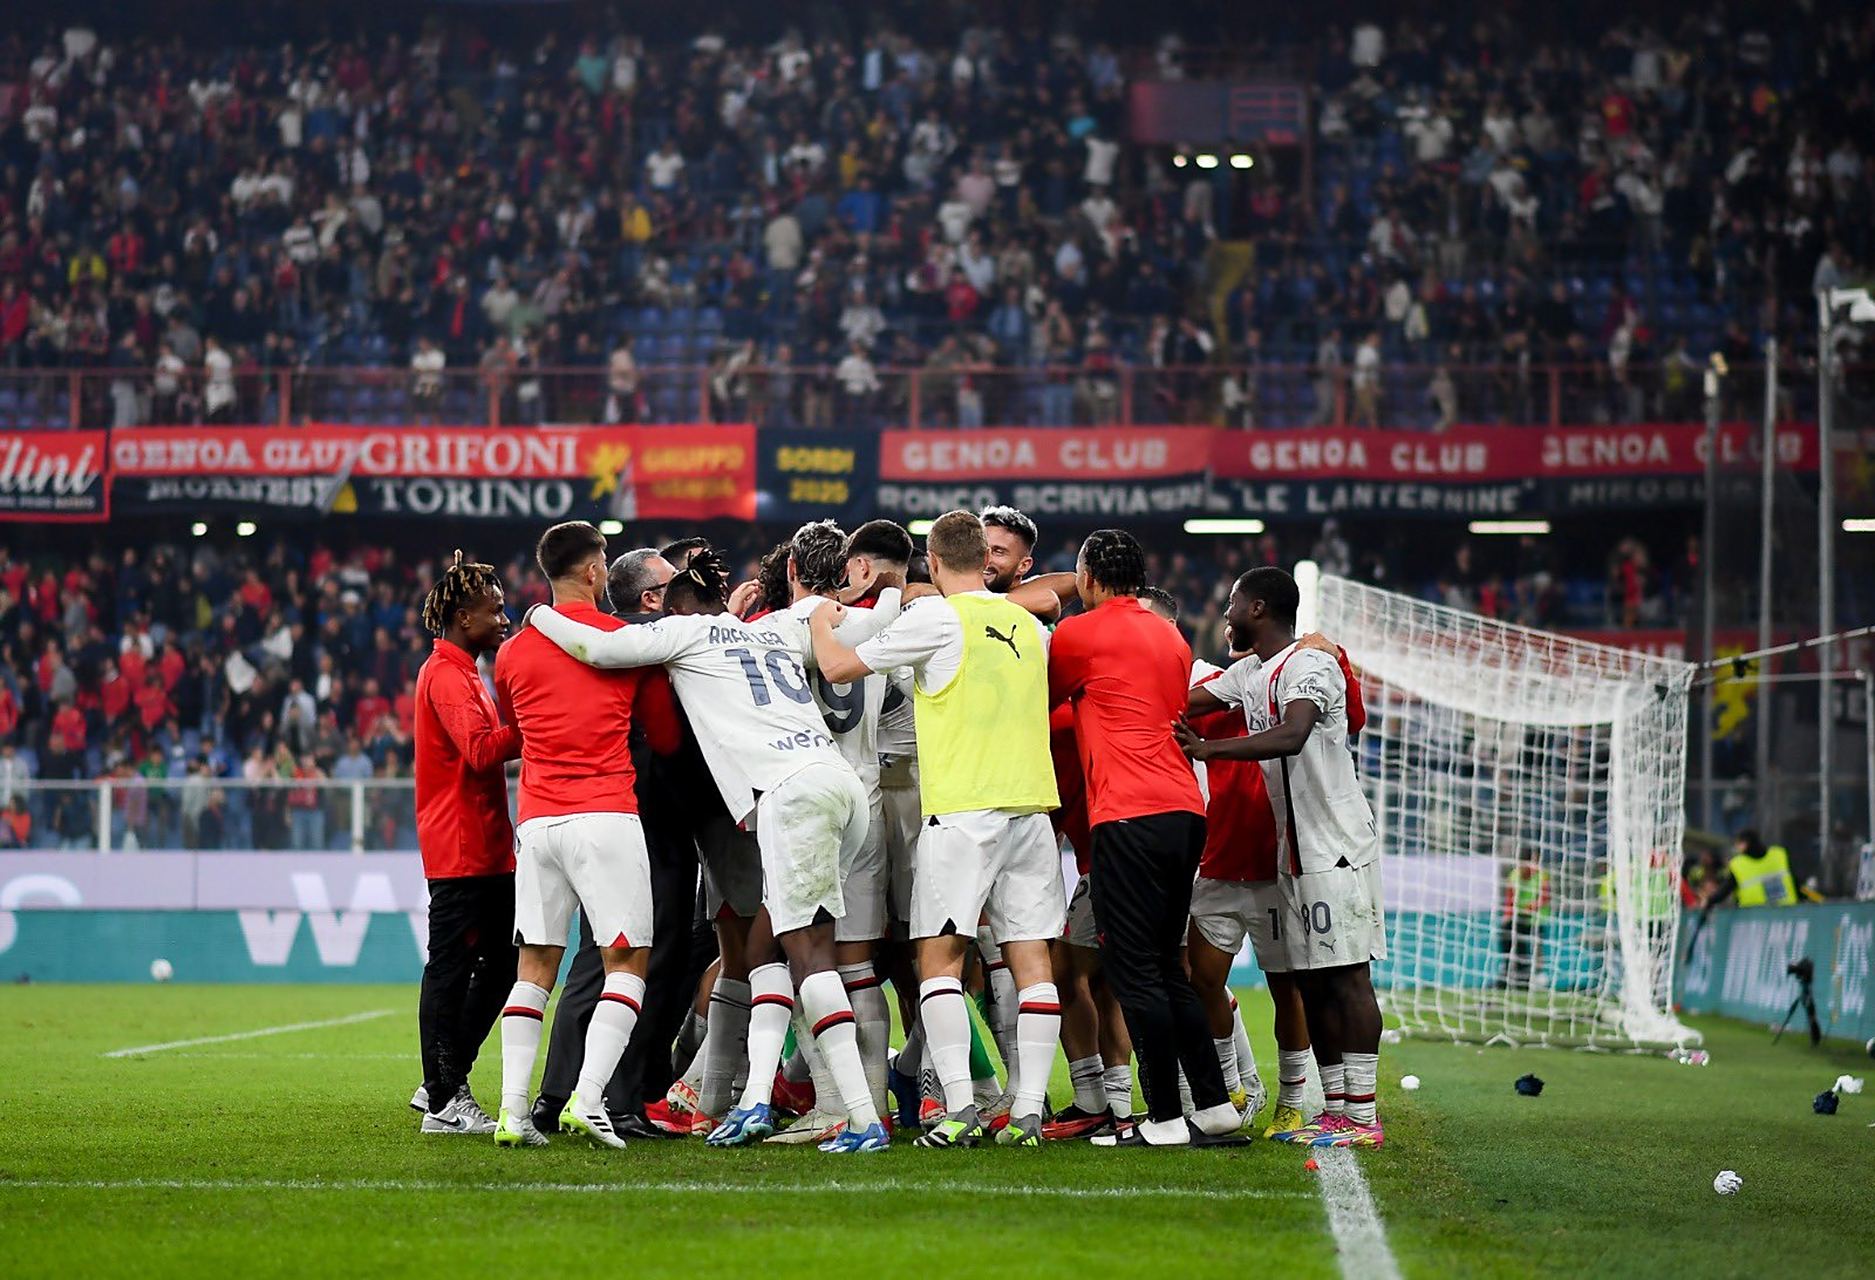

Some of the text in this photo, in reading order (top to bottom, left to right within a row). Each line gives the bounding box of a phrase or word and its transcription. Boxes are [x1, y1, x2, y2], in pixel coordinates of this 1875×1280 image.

[114, 440, 253, 470] GENOA
[361, 433, 578, 474] GRIFONI
[903, 439, 1169, 472] GENOA CLUB
[1250, 440, 1488, 472] GENOA CLUB
[371, 478, 574, 518] TORINO
[877, 484, 998, 513] RONCO
[1014, 485, 1150, 515] SCRIVIA
[724, 648, 812, 706] 10
[1267, 907, 1284, 941] 1
[1300, 901, 1332, 935] 80
